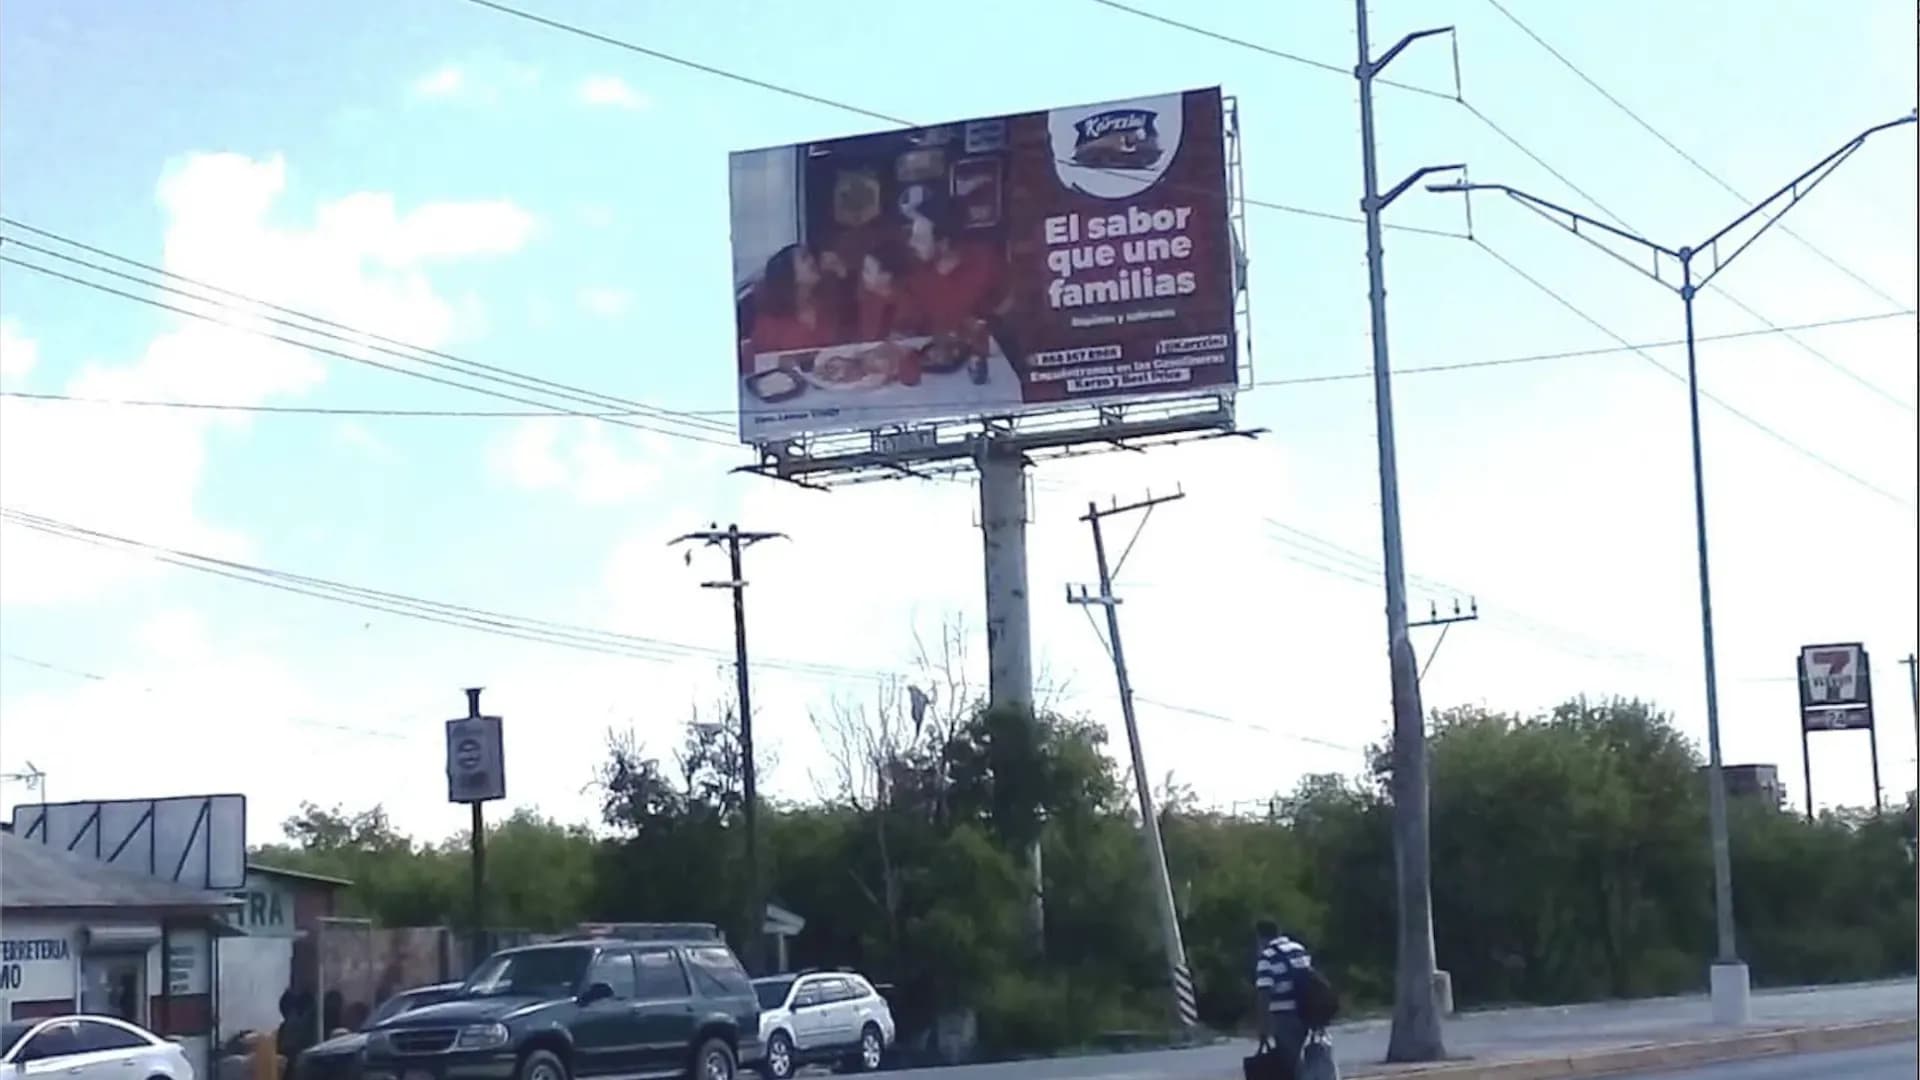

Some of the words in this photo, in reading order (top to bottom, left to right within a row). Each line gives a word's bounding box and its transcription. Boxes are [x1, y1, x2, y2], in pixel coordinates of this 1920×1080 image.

[1045, 214, 1080, 244] El
[1087, 206, 1191, 239] sabor
[1048, 243, 1115, 277] que
[1122, 235, 1192, 263] une
[1049, 267, 1196, 308] familias
[1116, 364, 1132, 374] en
[1133, 360, 1151, 371] las
[1812, 650, 1850, 676] 7
